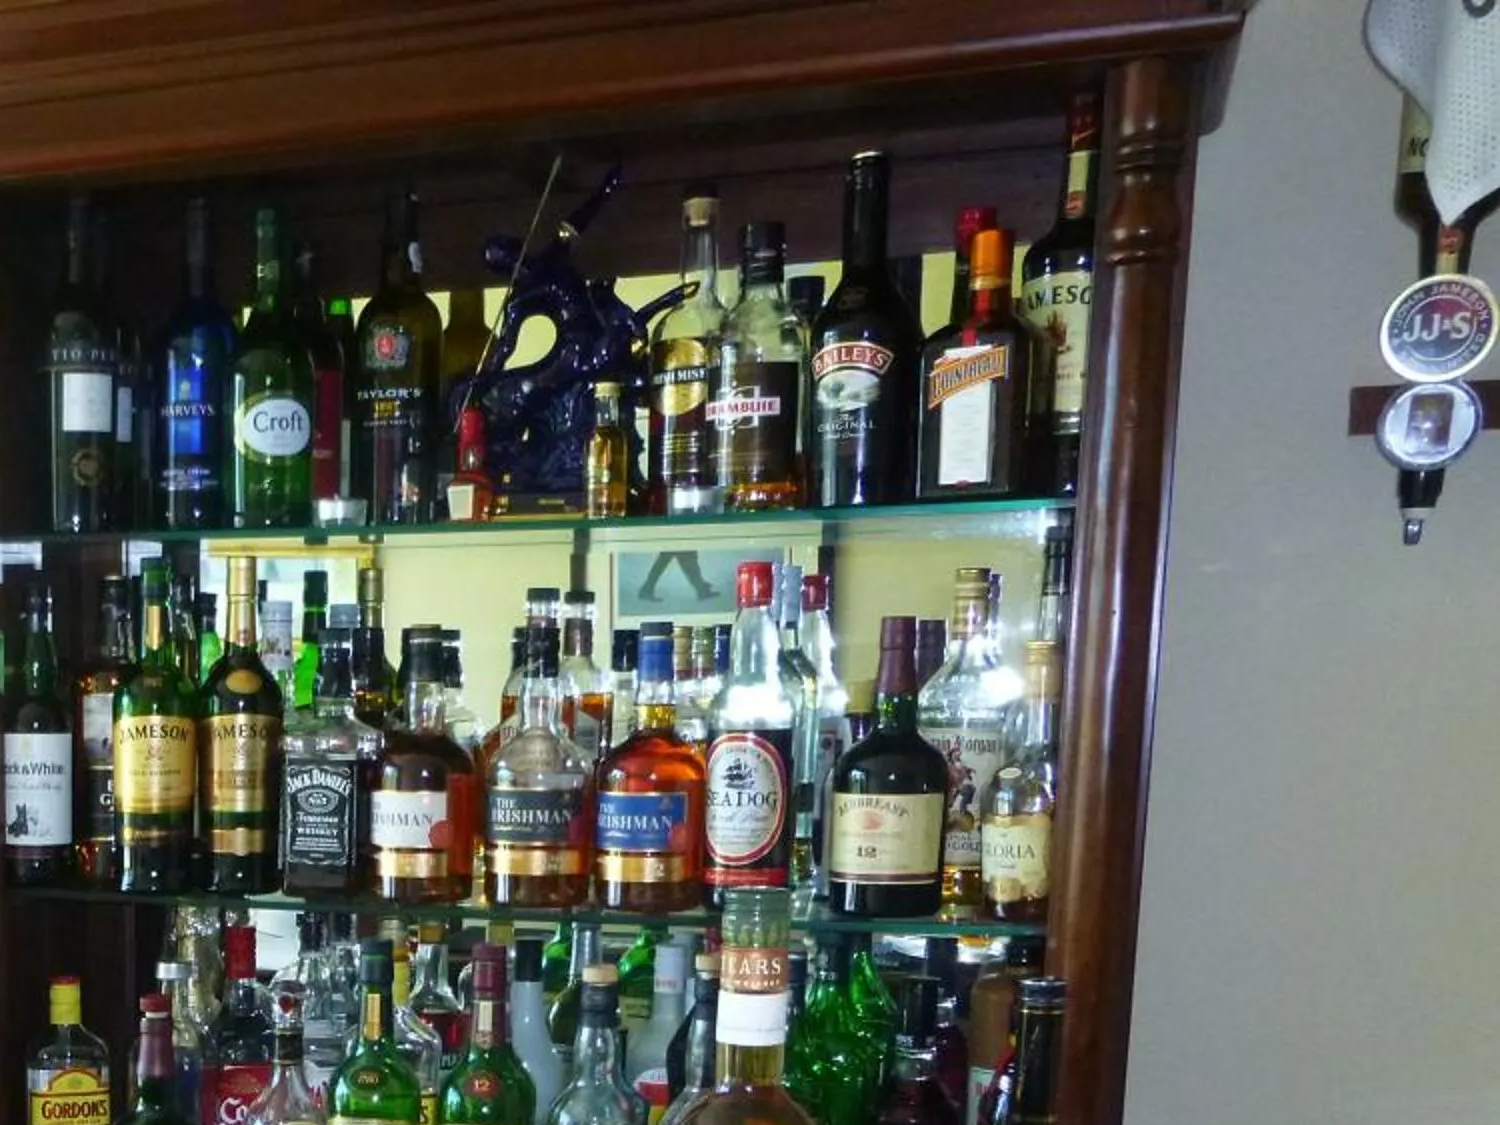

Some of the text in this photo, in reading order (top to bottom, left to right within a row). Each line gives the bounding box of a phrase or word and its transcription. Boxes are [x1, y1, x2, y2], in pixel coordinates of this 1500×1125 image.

[814, 344, 886, 370] BAILEYS
[161, 403, 216, 416] HARVEYS
[253, 410, 303, 433] Croft
[120, 724, 188, 745] JAMESON
[496, 799, 515, 809] THE
[491, 809, 572, 824] IRISHMAN
